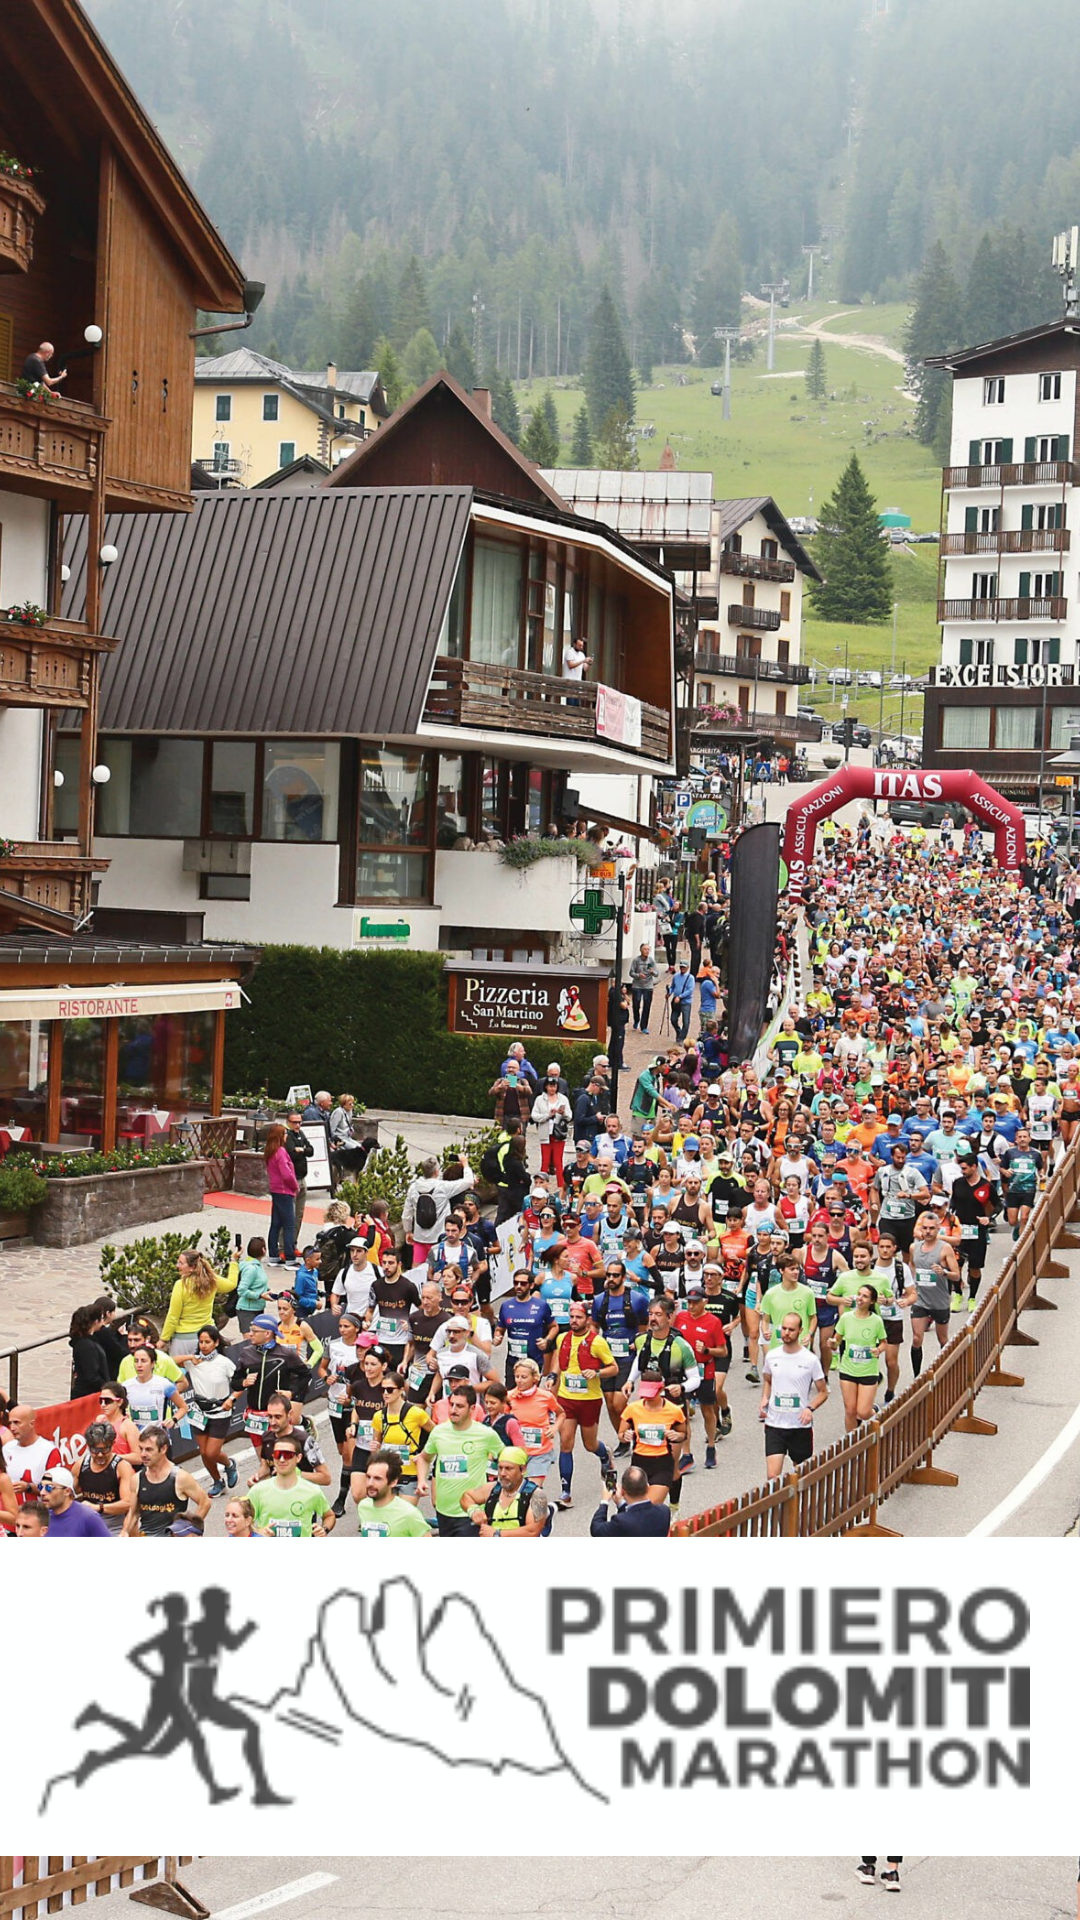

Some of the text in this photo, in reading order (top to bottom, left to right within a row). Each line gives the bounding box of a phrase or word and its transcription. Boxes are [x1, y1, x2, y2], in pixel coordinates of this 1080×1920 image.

[935, 664, 1061, 687] EXCELSIOR
[873, 771, 943, 799] ITAS
[788, 859, 805, 898] ITAS
[464, 978, 550, 1006] Pizzeria
[58, 999, 139, 1017] RISTORANTE
[472, 1003, 544, 1020] San Martino
[444, 1461, 460, 1472] 1272
